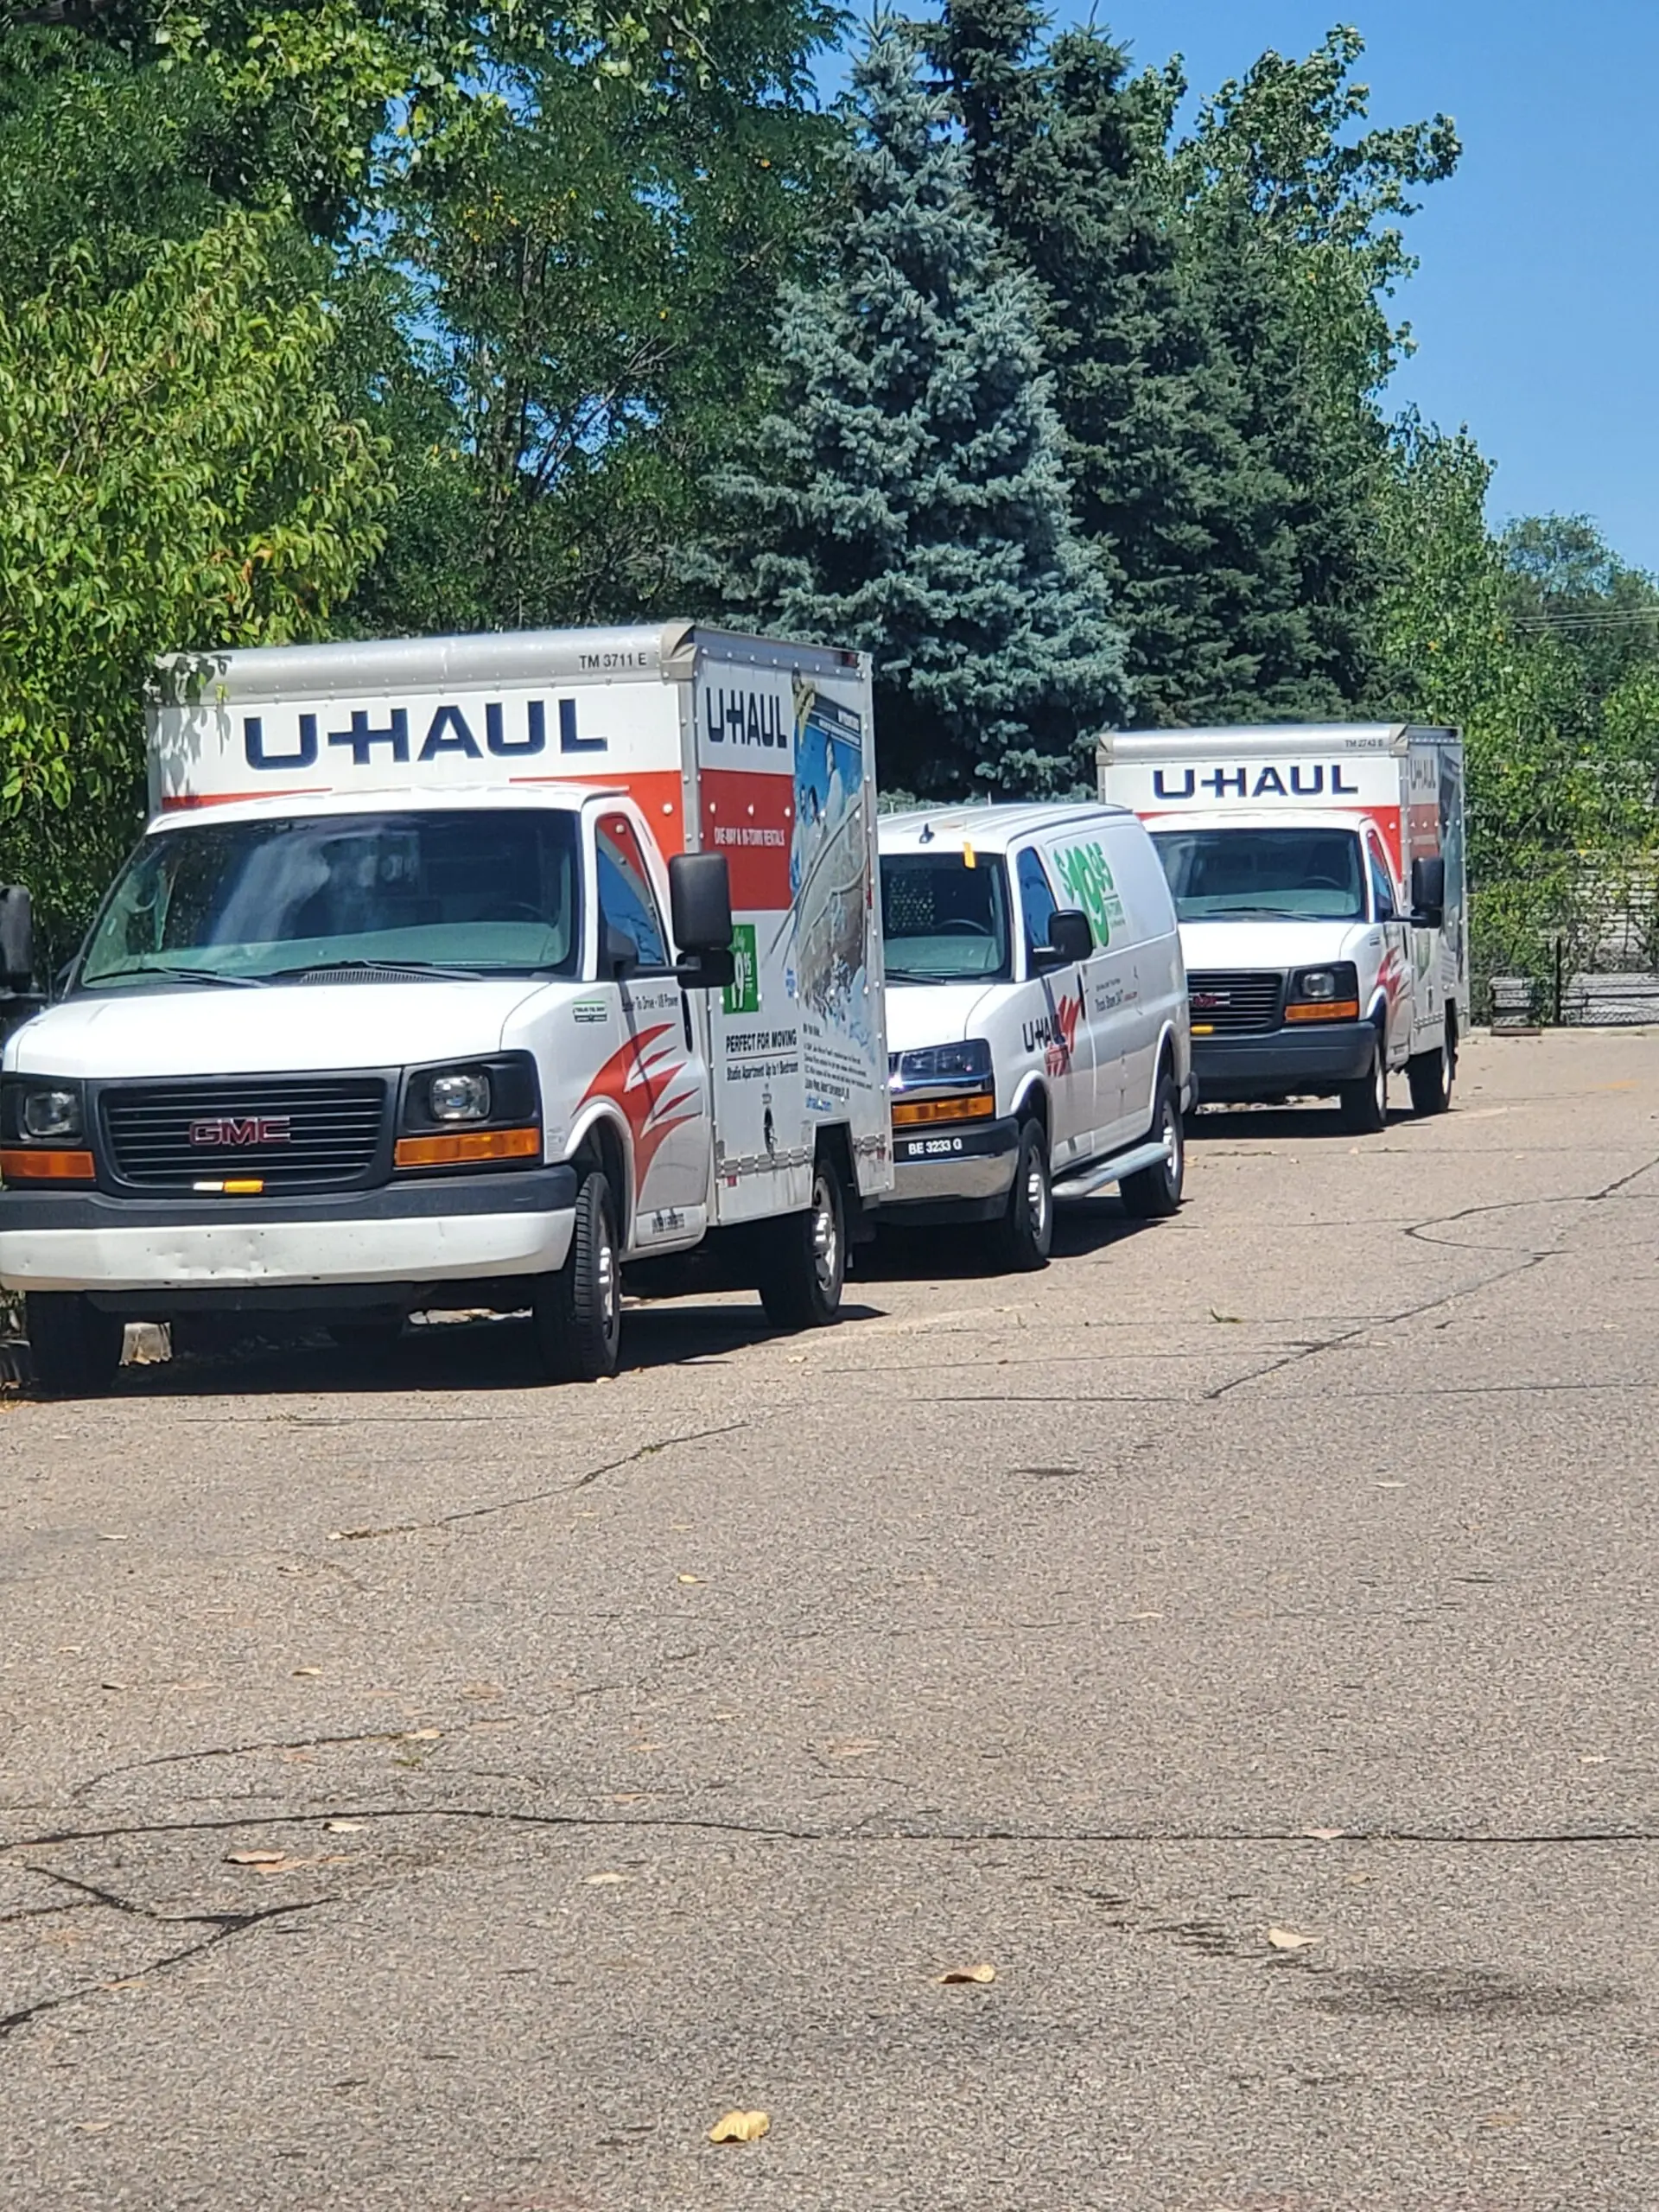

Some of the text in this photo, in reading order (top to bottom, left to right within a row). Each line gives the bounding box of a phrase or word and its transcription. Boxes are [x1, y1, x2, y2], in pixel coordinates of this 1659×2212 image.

[579, 652, 646, 669] TM 3711 E
[705, 686, 788, 749] U-HAUL
[243, 697, 608, 771] U-HAUL
[1152, 764, 1358, 800] U-HAUL
[726, 1033, 756, 1053] PERFECT
[756, 1031, 770, 1050] FOR
[771, 1027, 797, 1048] MOVING
[189, 1116, 291, 1146] GMC
[908, 1142, 925, 1155] BE
[925, 1140, 951, 1154] 3233
